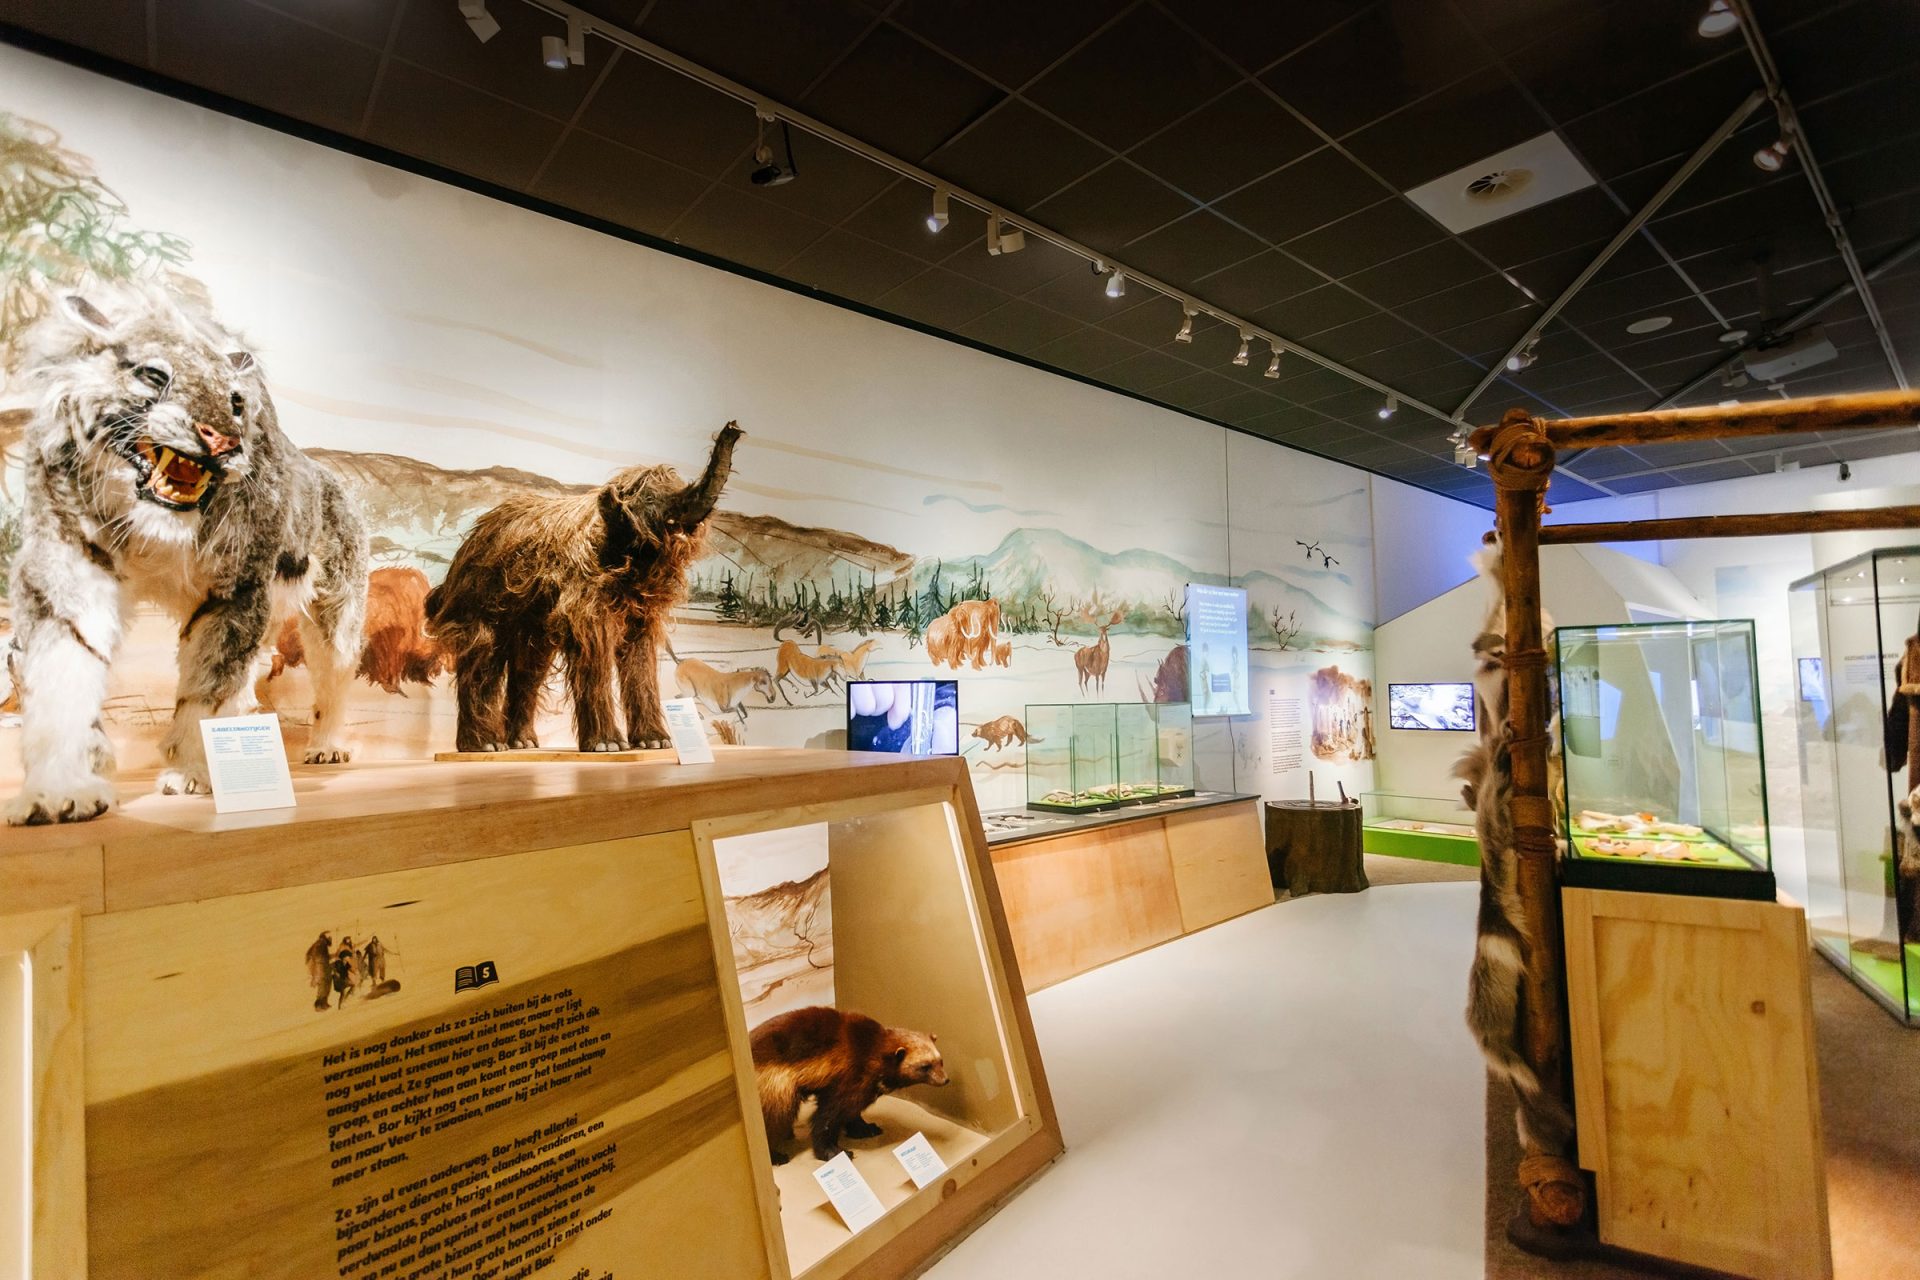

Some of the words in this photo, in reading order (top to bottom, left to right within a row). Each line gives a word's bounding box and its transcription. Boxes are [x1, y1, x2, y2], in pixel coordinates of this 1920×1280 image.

[482, 966, 490, 978] 5
[323, 1051, 346, 1067] Het
[349, 1047, 360, 1060] is
[364, 1042, 387, 1055] nog
[389, 1029, 432, 1048] donker
[434, 1023, 451, 1034] als
[454, 1019, 467, 1030] ze
[469, 1010, 491, 1025] zich
[493, 1003, 525, 1018] buiten
[527, 995, 539, 1009] bij
[540, 994, 552, 1004] de
[554, 988, 573, 1000] rots
[324, 1055, 402, 1084] verzamelen.
[404, 1044, 425, 1060] Het
[427, 1030, 474, 1052] sneeuwt
[477, 1023, 497, 1038] niet
[499, 1017, 526, 1031] meer,
[527, 1009, 553, 1022] maar
[555, 1005, 565, 1014] er
[566, 998, 582, 1014] ligt
[325, 1086, 350, 1101] nog
[354, 1075, 376, 1092] wel
[379, 1067, 403, 1083] wat
[406, 1055, 450, 1075] sneeuw
[452, 1047, 474, 1061] hier
[476, 1043, 489, 1053] en
[491, 1034, 517, 1048] daar.
[519, 1028, 537, 1040] Bor
[539, 1017, 564, 1033] heeft
[566, 1011, 585, 1025] zich
[586, 1007, 600, 1018] dik
[327, 1083, 405, 1117] aangekleed.
[407, 1079, 422, 1092] Ze
[424, 1070, 453, 1089] gaan
[455, 1065, 470, 1076] op
[471, 1057, 496, 1070] weg.
[498, 1049, 517, 1061] Bor
[519, 1042, 532, 1055] zit
[534, 1036, 546, 1050] bij
[548, 1034, 559, 1045] de
[561, 1025, 590, 1040] eerste
[328, 1115, 370, 1138] groep,
[372, 1108, 388, 1120] en
[391, 1093, 430, 1113] achter
[432, 1085, 454, 1099] hen
[456, 1078, 477, 1090] aan
[480, 1065, 507, 1083] komt
[509, 1061, 528, 1073] een
[529, 1050, 558, 1069] groep
[560, 1042, 577, 1056] met
[579, 1037, 599, 1049] eten
[600, 1032, 611, 1041] en
[330, 1130, 375, 1152] tenten.
[378, 1120, 401, 1135] Bor
[404, 1107, 432, 1126] kijkt
[435, 1100, 457, 1115] nog
[459, 1093, 480, 1106] een
[482, 1083, 506, 1098] keer
[508, 1074, 532, 1089] naar
[534, 1065, 550, 1079] het
[552, 1048, 606, 1073] tentenkamp
[331, 1155, 352, 1169] om
[355, 1142, 387, 1161] naar
[388, 1131, 417, 1148] Veer
[420, 1125, 432, 1137] te
[435, 1108, 483, 1132] zwaaien,
[484, 1096, 513, 1113] maar
[515, 1087, 528, 1102] hij
[530, 1081, 548, 1096] ziet
[550, 1074, 573, 1089] haar
[574, 1065, 592, 1080] niet
[332, 1167, 367, 1187] meer
[370, 1153, 409, 1172] staan.
[335, 1209, 352, 1222] Ze
[356, 1196, 379, 1214] zijn
[382, 1188, 394, 1203] al
[398, 1178, 428, 1196] even
[430, 1153, 490, 1183] onderweg.
[492, 1144, 512, 1158] Bor
[514, 1129, 542, 1149] heeft
[543, 1113, 577, 1136] allerlei
[336, 1204, 406, 1240] bijzondere
[409, 1187, 448, 1209] dieren
[451, 1170, 490, 1196] gezien,
[492, 1151, 536, 1174] elanden,
[537, 1129, 586, 1155] rendieren,
[587, 1121, 604, 1133] een
[337, 1237, 370, 1262] paar
[373, 1218, 418, 1243] bizons,
[420, 1202, 452, 1226] grote
[456, 1185, 492, 1207] harige
[494, 1157, 557, 1191] neushoorns,
[558, 1148, 576, 1161] een
[339, 1235, 417, 1276] verdwaalde
[419, 1212, 468, 1244] poolvos
[470, 1199, 492, 1218] met
[494, 1191, 514, 1207] een
[516, 1168, 564, 1200] prachtige
[566, 1157, 590, 1173] witte
[591, 1143, 617, 1162] vacht
[380, 1263, 397, 1277] nu
[399, 1254, 416, 1268] en
[418, 1242, 441, 1259] dan
[444, 1222, 479, 1247] sprint
[481, 1217, 494, 1229] er
[496, 1207, 516, 1222] een
[518, 1178, 579, 1212] sneeuwhaas
[580, 1158, 616, 1182] voorbij.
[444, 1239, 483, 1264] bizons
[485, 1226, 507, 1244] met
[509, 1217, 529, 1233] hun
[531, 1198, 568, 1226] gebries
[570, 1192, 582, 1203] en
[584, 1185, 595, 1197] de
[451, 1263, 473, 1279] hun
[475, 1246, 505, 1270] grote
[508, 1226, 545, 1251] hoorns
[547, 1215, 568, 1232] zien
[569, 1208, 580, 1220] er
[502, 1254, 523, 1271] hen
[525, 1237, 551, 1259] moet
[553, 1232, 563, 1249] je
[565, 1221, 584, 1238] niet
[585, 1208, 613, 1227] onder
[505, 1264, 532, 1280] nkt
[534, 1255, 555, 1271] Bor.
